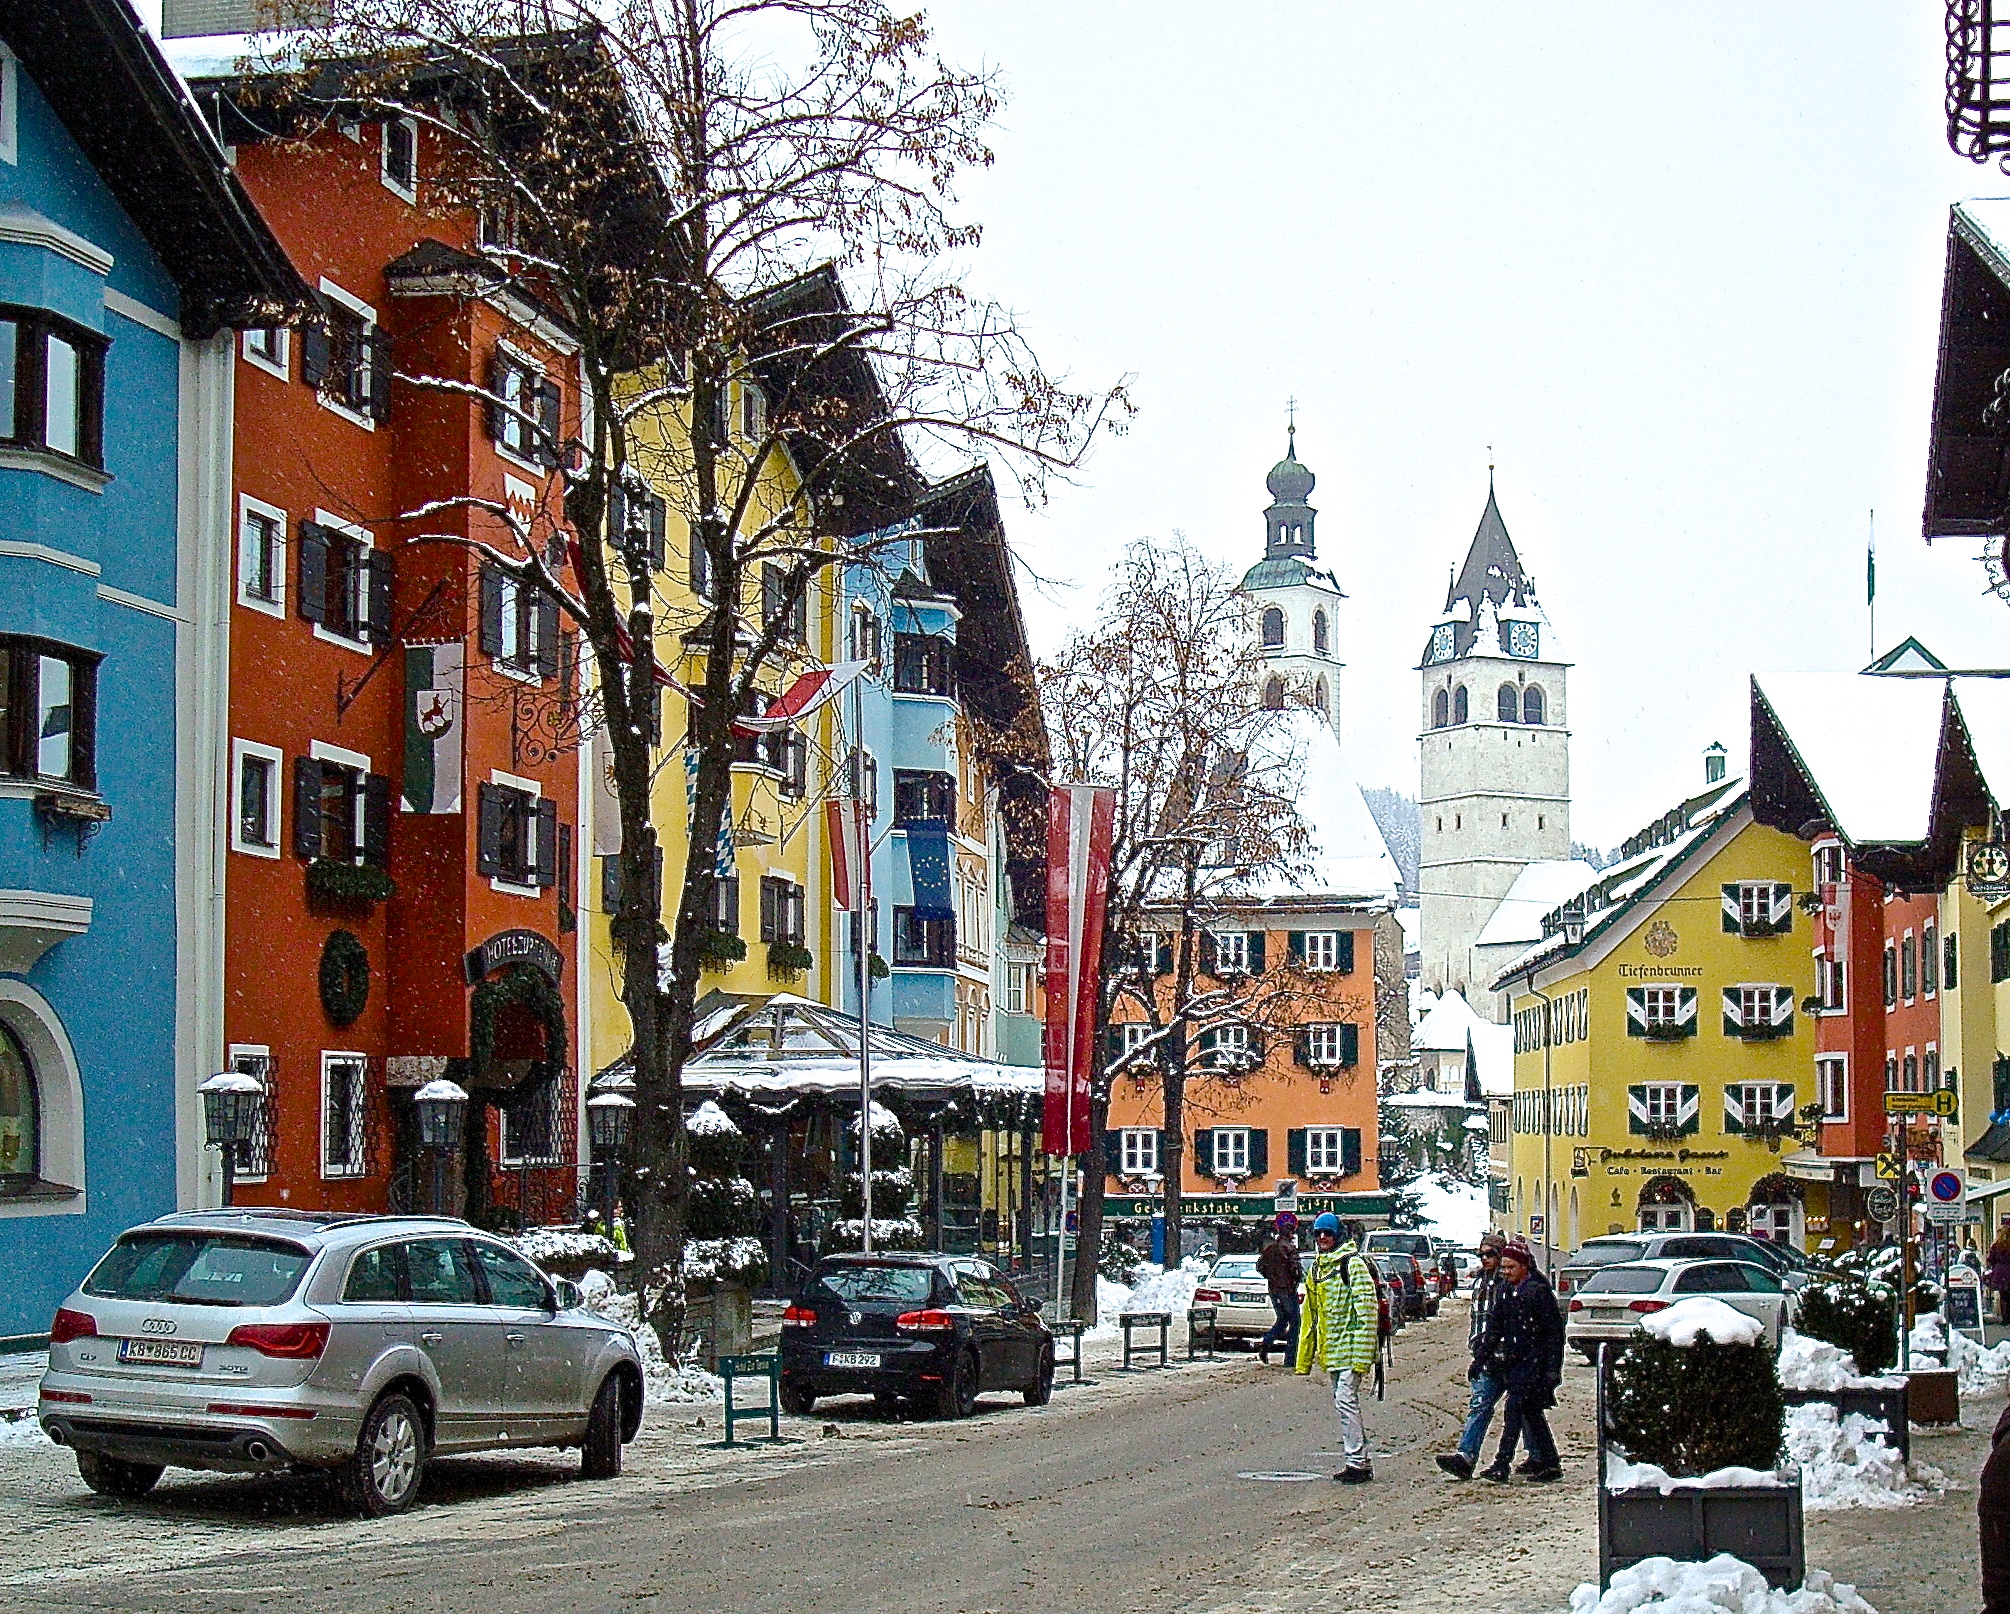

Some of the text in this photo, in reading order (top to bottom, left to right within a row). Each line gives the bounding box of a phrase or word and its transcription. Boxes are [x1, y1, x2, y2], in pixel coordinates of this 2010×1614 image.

[1618, 963, 1703, 979] Tiefenbrunner
[1936, 1094, 1952, 1112] H
[1640, 1166, 1693, 1176] Restaurant
[1704, 1166, 1722, 1176] Bar
[1134, 1202, 1239, 1214] Genkstube
[128, 1341, 197, 1361] KB 865 CC
